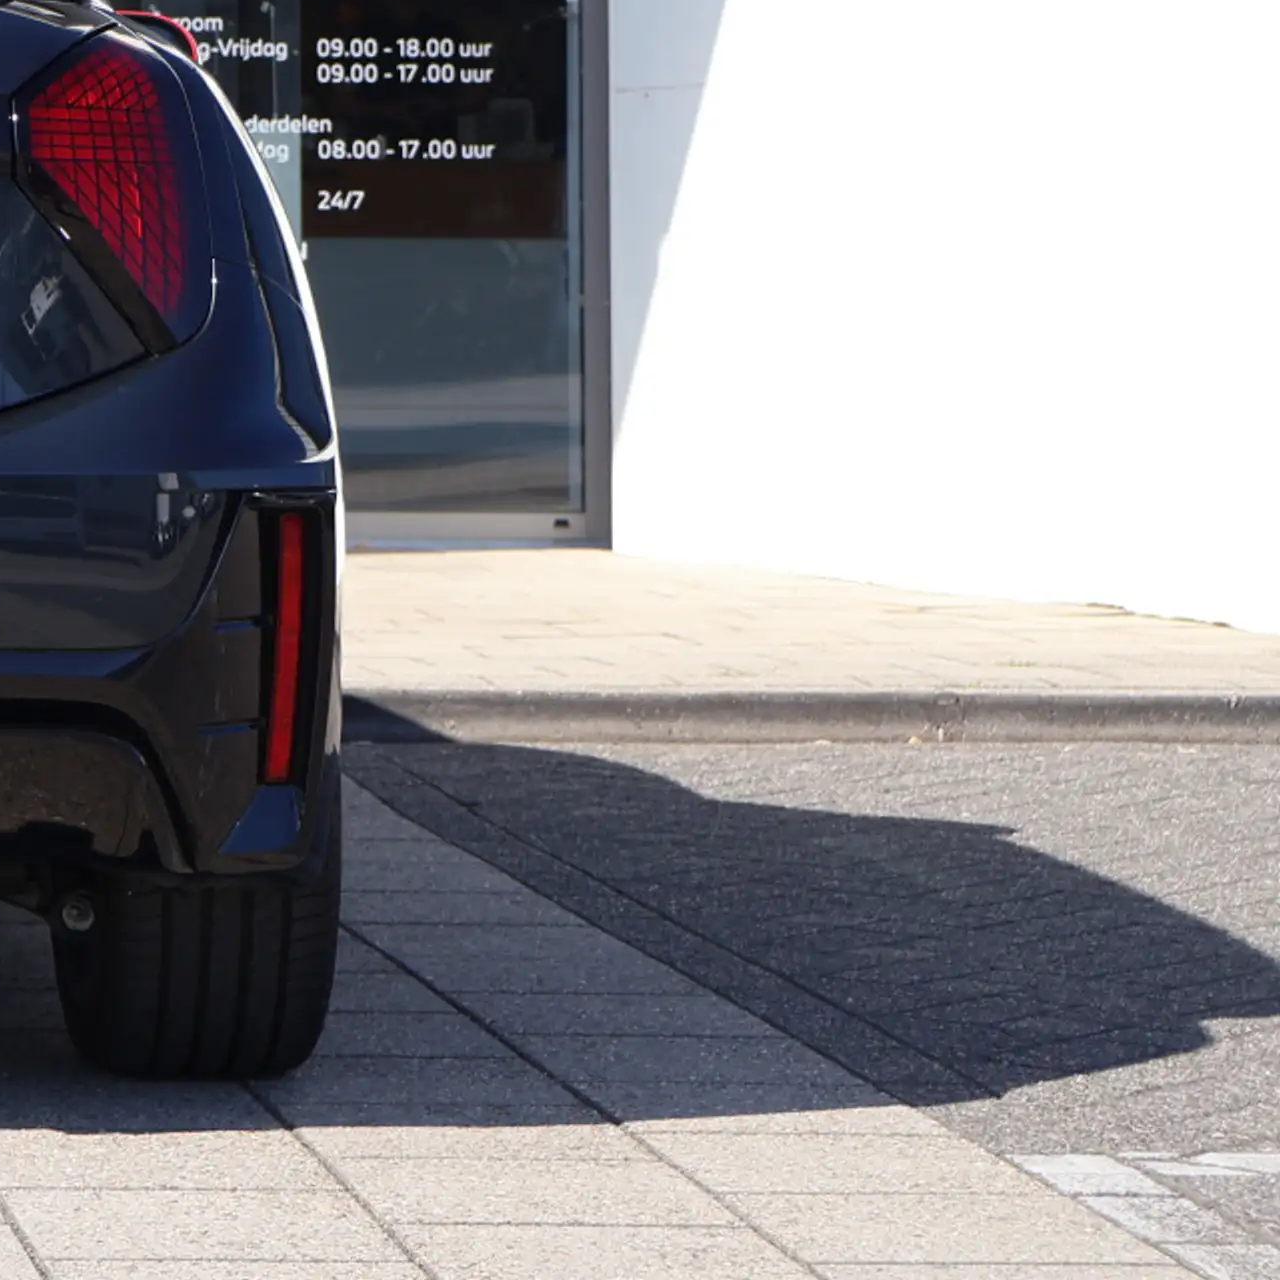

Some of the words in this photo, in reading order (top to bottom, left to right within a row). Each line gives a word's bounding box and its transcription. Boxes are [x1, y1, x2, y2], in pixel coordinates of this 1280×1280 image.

[197, 38, 288, 62] g-Vrijdag
[316, 38, 378, 58] 09.00
[396, 38, 454, 58] 18.00
[459, 42, 493, 58] uur
[316, 64, 378, 83] 09.00
[460, 68, 494, 83] uur
[244, 114, 333, 133] derdelen
[317, 140, 380, 160] 08.00
[461, 144, 496, 160] uur
[317, 190, 365, 210] 24/7
